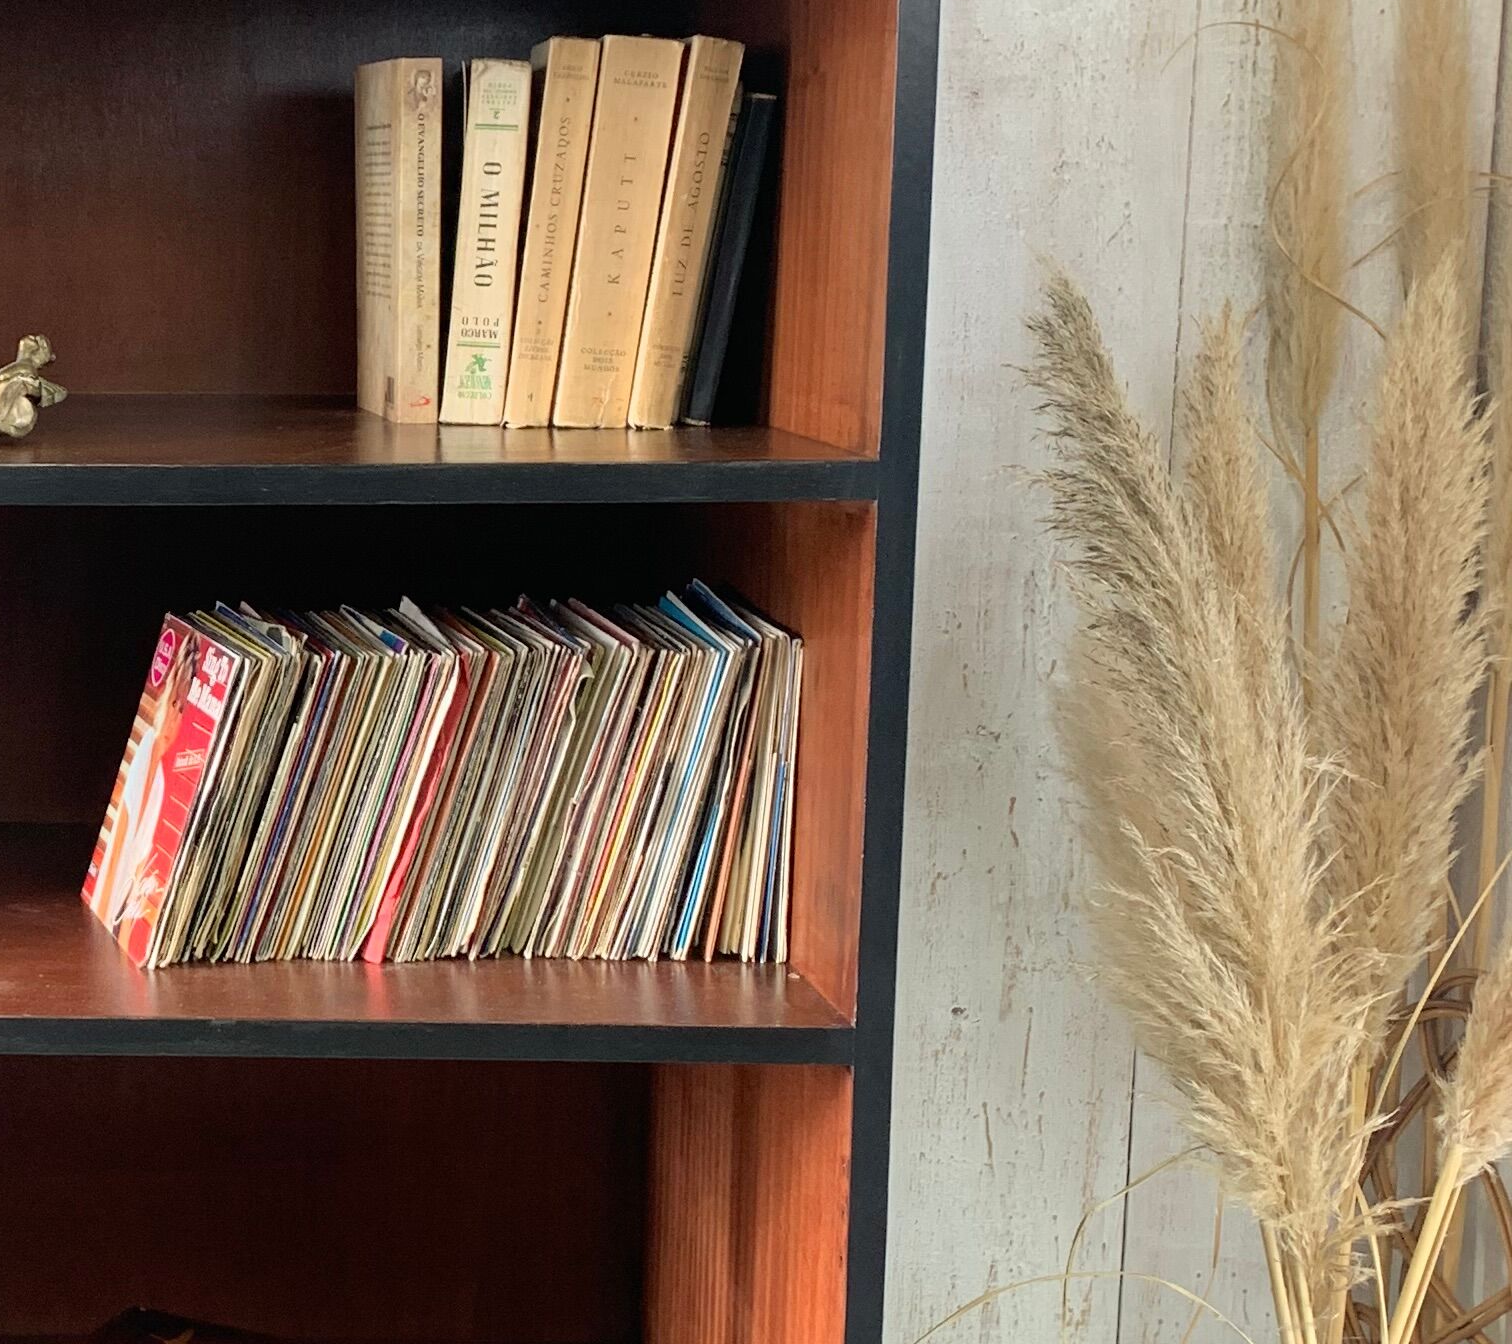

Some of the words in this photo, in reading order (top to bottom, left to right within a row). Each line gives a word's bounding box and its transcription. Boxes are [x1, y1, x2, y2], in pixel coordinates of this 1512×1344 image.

[417, 113, 425, 121] O
[483, 162, 502, 175] O
[416, 190, 425, 237] SECRETO
[538, 214, 558, 303] CAMINHOS
[550, 116, 570, 206] CRUZADOS
[608, 154, 636, 285] KAPUTT
[672, 260, 688, 296] LUZ
[681, 226, 694, 247] DE
[688, 131, 710, 212] AGOSTO
[474, 189, 500, 287] MILHÃO
[461, 328, 498, 339] MARCO
[462, 316, 499, 327] POLO
